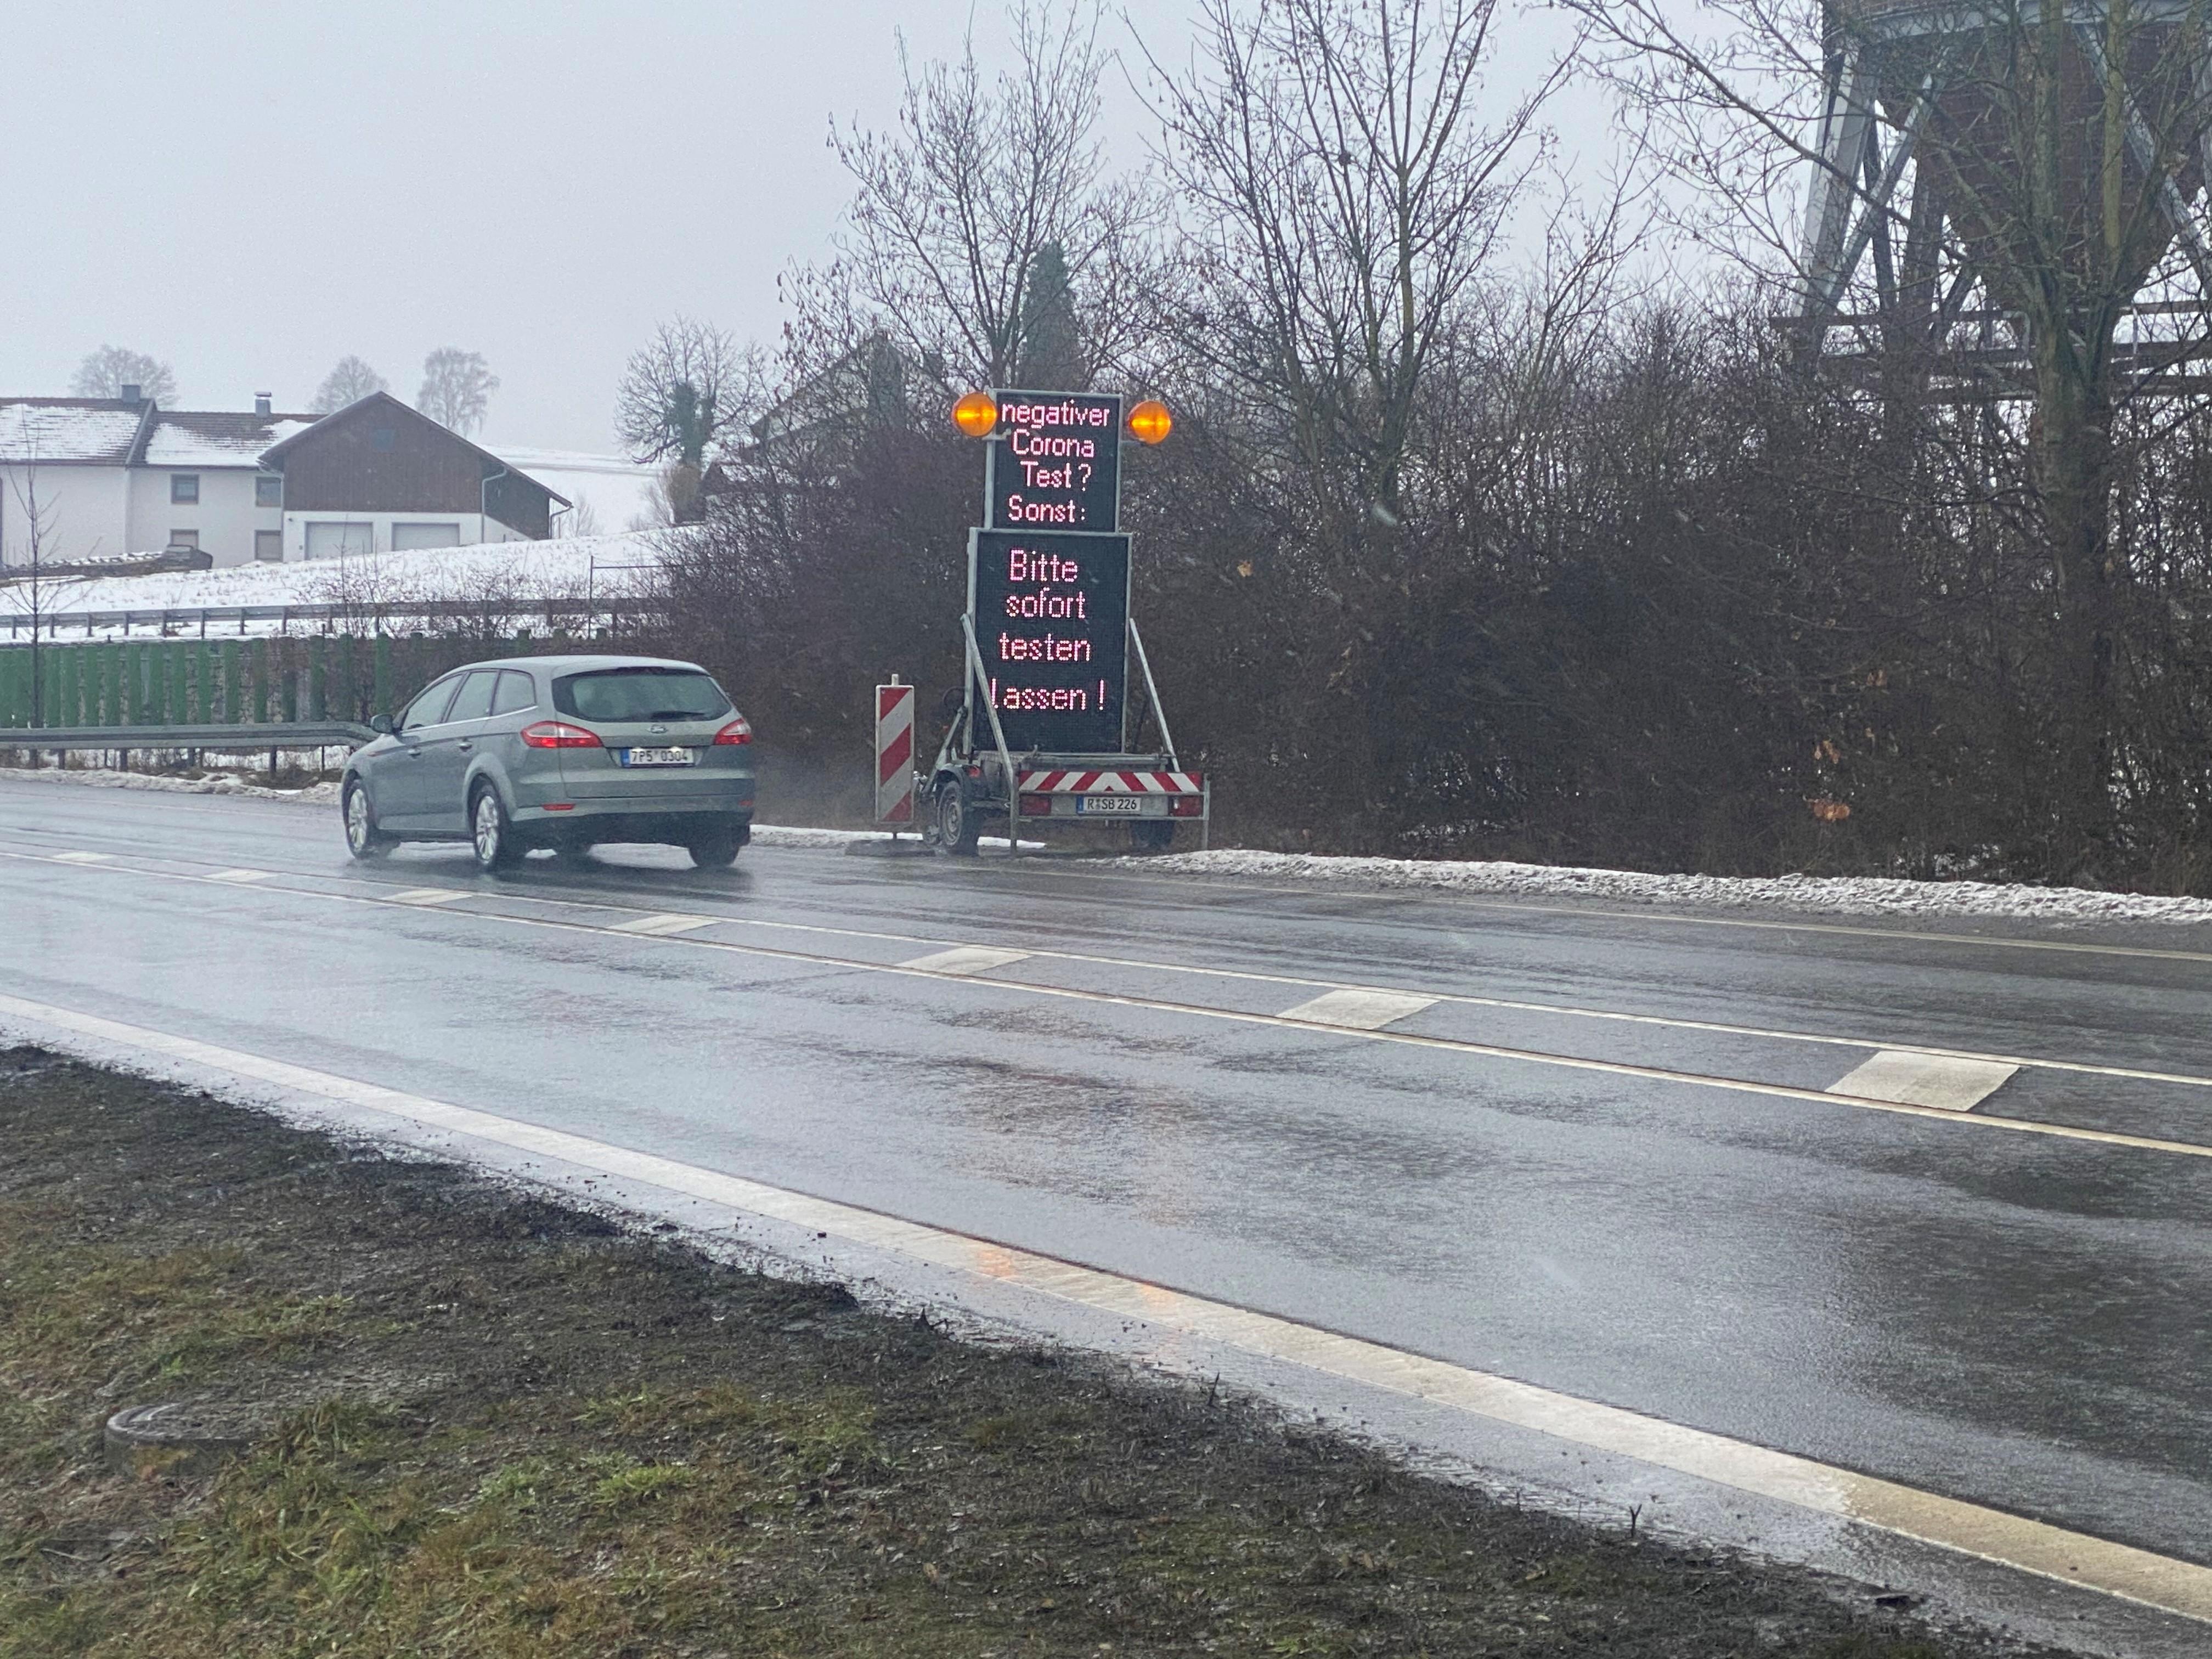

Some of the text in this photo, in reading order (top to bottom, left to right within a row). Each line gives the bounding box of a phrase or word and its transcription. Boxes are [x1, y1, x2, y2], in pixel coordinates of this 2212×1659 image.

[1001, 399, 1110, 429] negativer
[1012, 428, 1095, 458] Corona
[1008, 494, 1086, 523] Sonst:
[1009, 549, 1078, 583] Bitte
[1006, 586, 1086, 618] sofort
[999, 632, 1091, 662] testen
[991, 678, 1086, 710] lassen
[1118, 798, 1137, 810] 226
